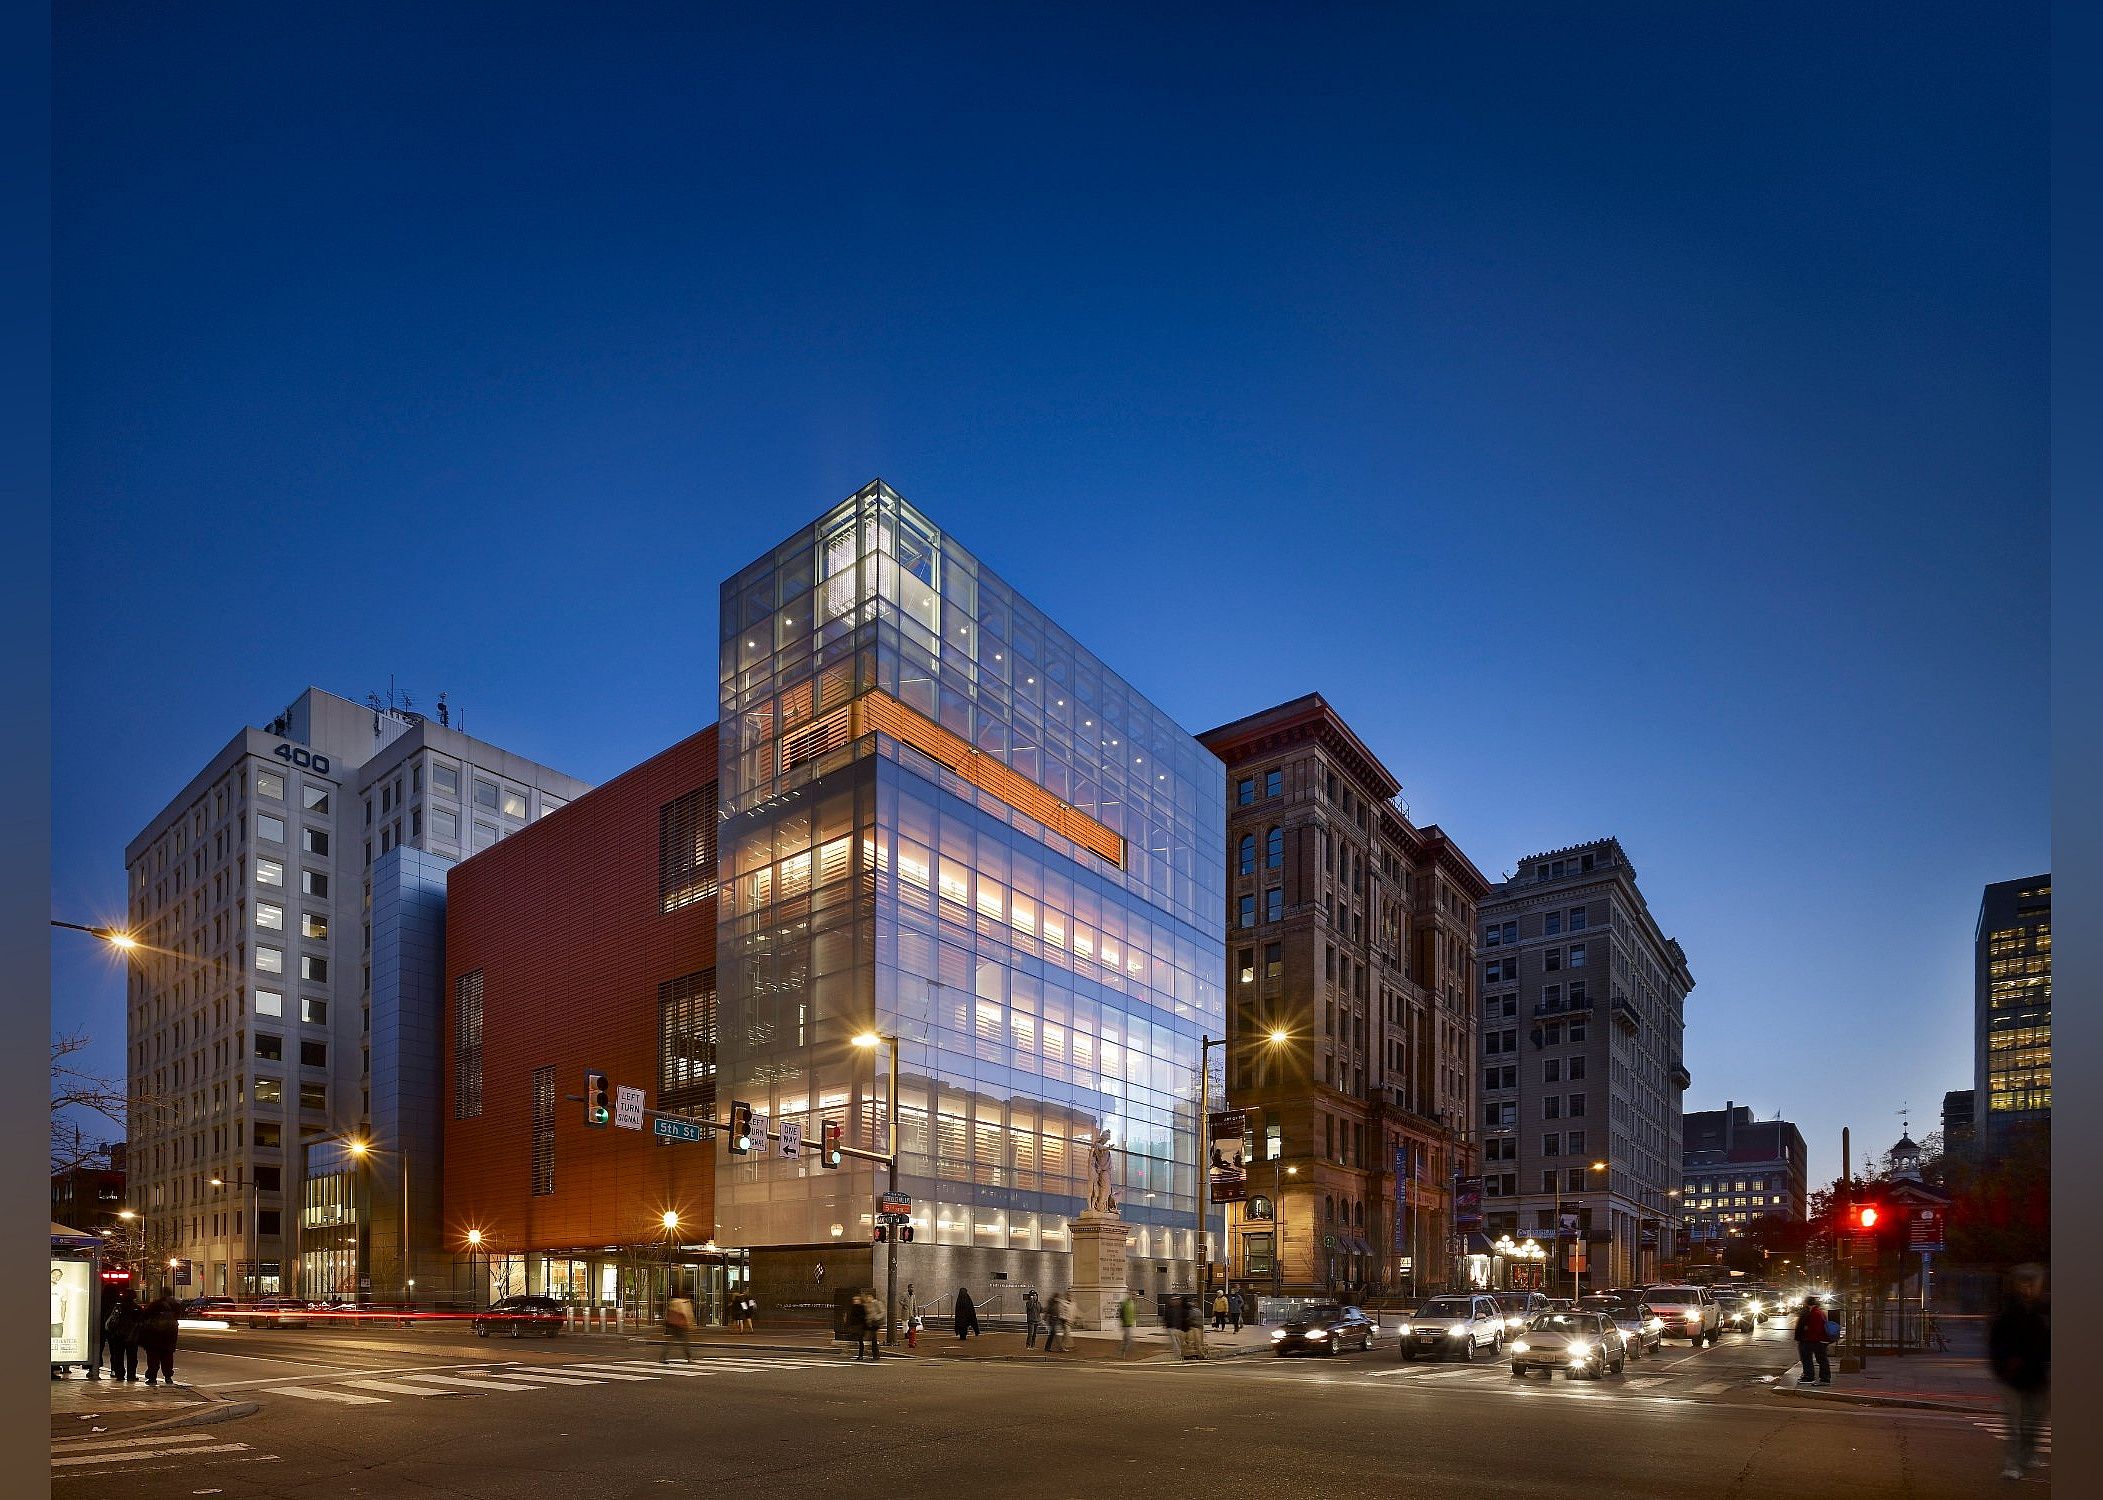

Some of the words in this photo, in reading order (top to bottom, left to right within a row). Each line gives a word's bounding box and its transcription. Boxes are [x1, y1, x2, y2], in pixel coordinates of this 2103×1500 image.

[274, 743, 330, 774] 400
[622, 1092, 640, 1102] LEFT
[620, 1103, 640, 1113] TURN
[617, 1114, 640, 1124] SIGNAL
[660, 1122, 679, 1135] 5th
[683, 1127, 695, 1138] St
[751, 1127, 764, 1137] URN
[784, 1125, 797, 1135] ONE
[783, 1136, 797, 1145] WAY
